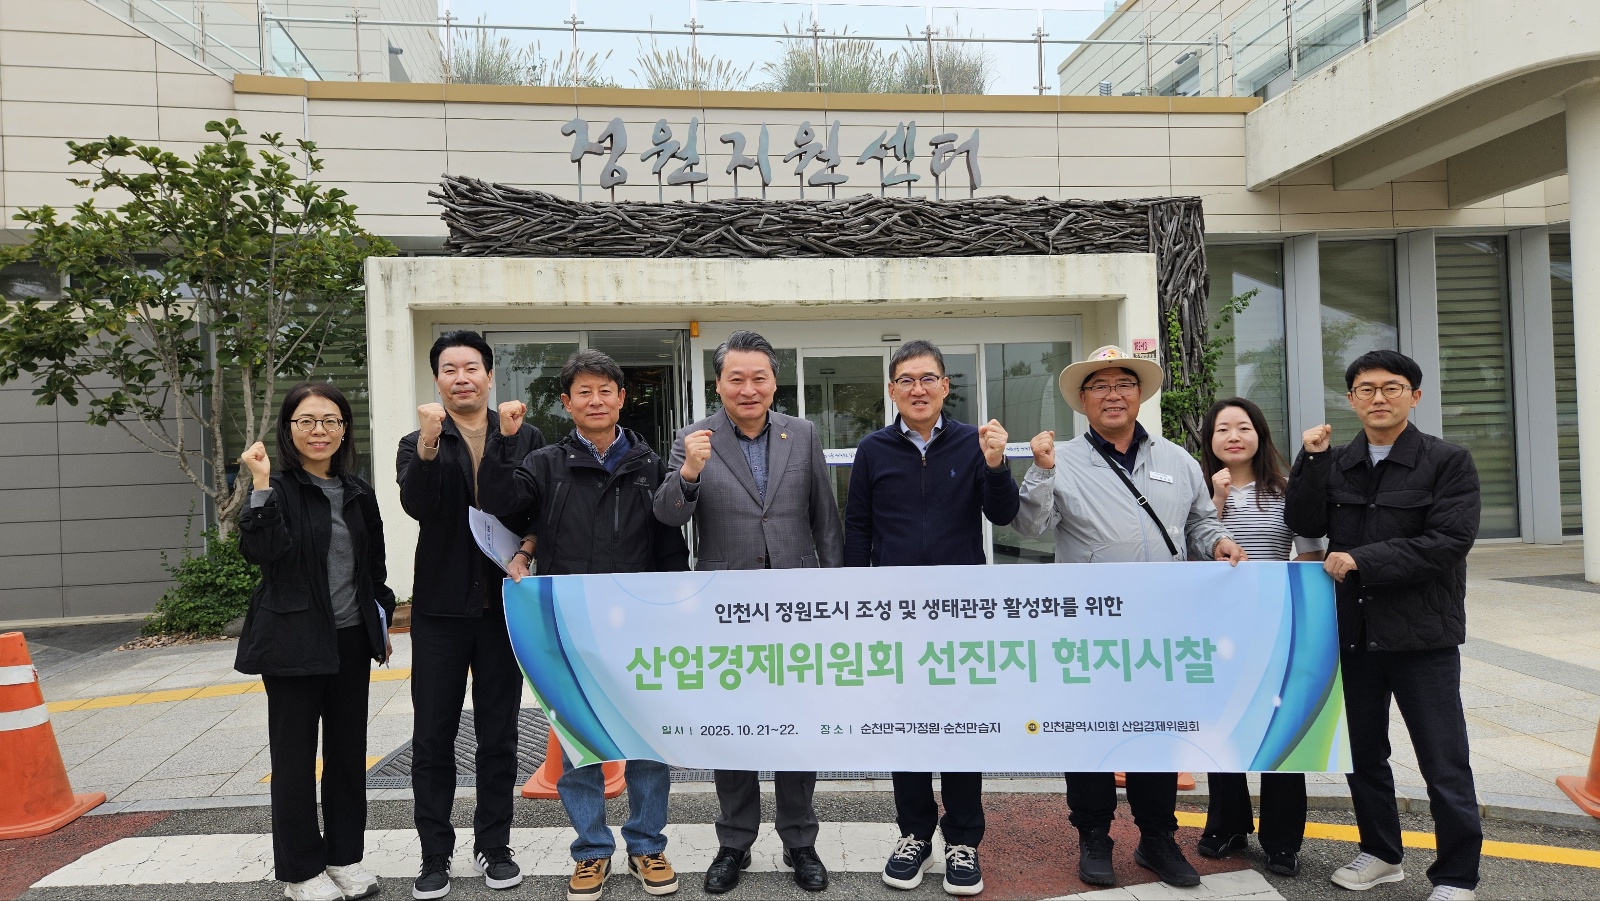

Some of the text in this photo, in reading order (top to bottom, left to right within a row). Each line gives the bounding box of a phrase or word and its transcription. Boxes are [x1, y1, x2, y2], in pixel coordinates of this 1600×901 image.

[561, 117, 981, 189] 정원지원센터
[715, 595, 1123, 624] 인천시 정원도시 조성 및 생태관광 활성화를 위한
[625, 636, 1216, 692] 산업경제위원회 선진지 현지시찰
[700, 725, 734, 736] 2025.
[736, 724, 754, 736] 10.
[756, 724, 799, 736] 21~22.
[1042, 720, 1119, 734] 인천광역시의회
[1121, 720, 1200, 734] 산업경제위원회
